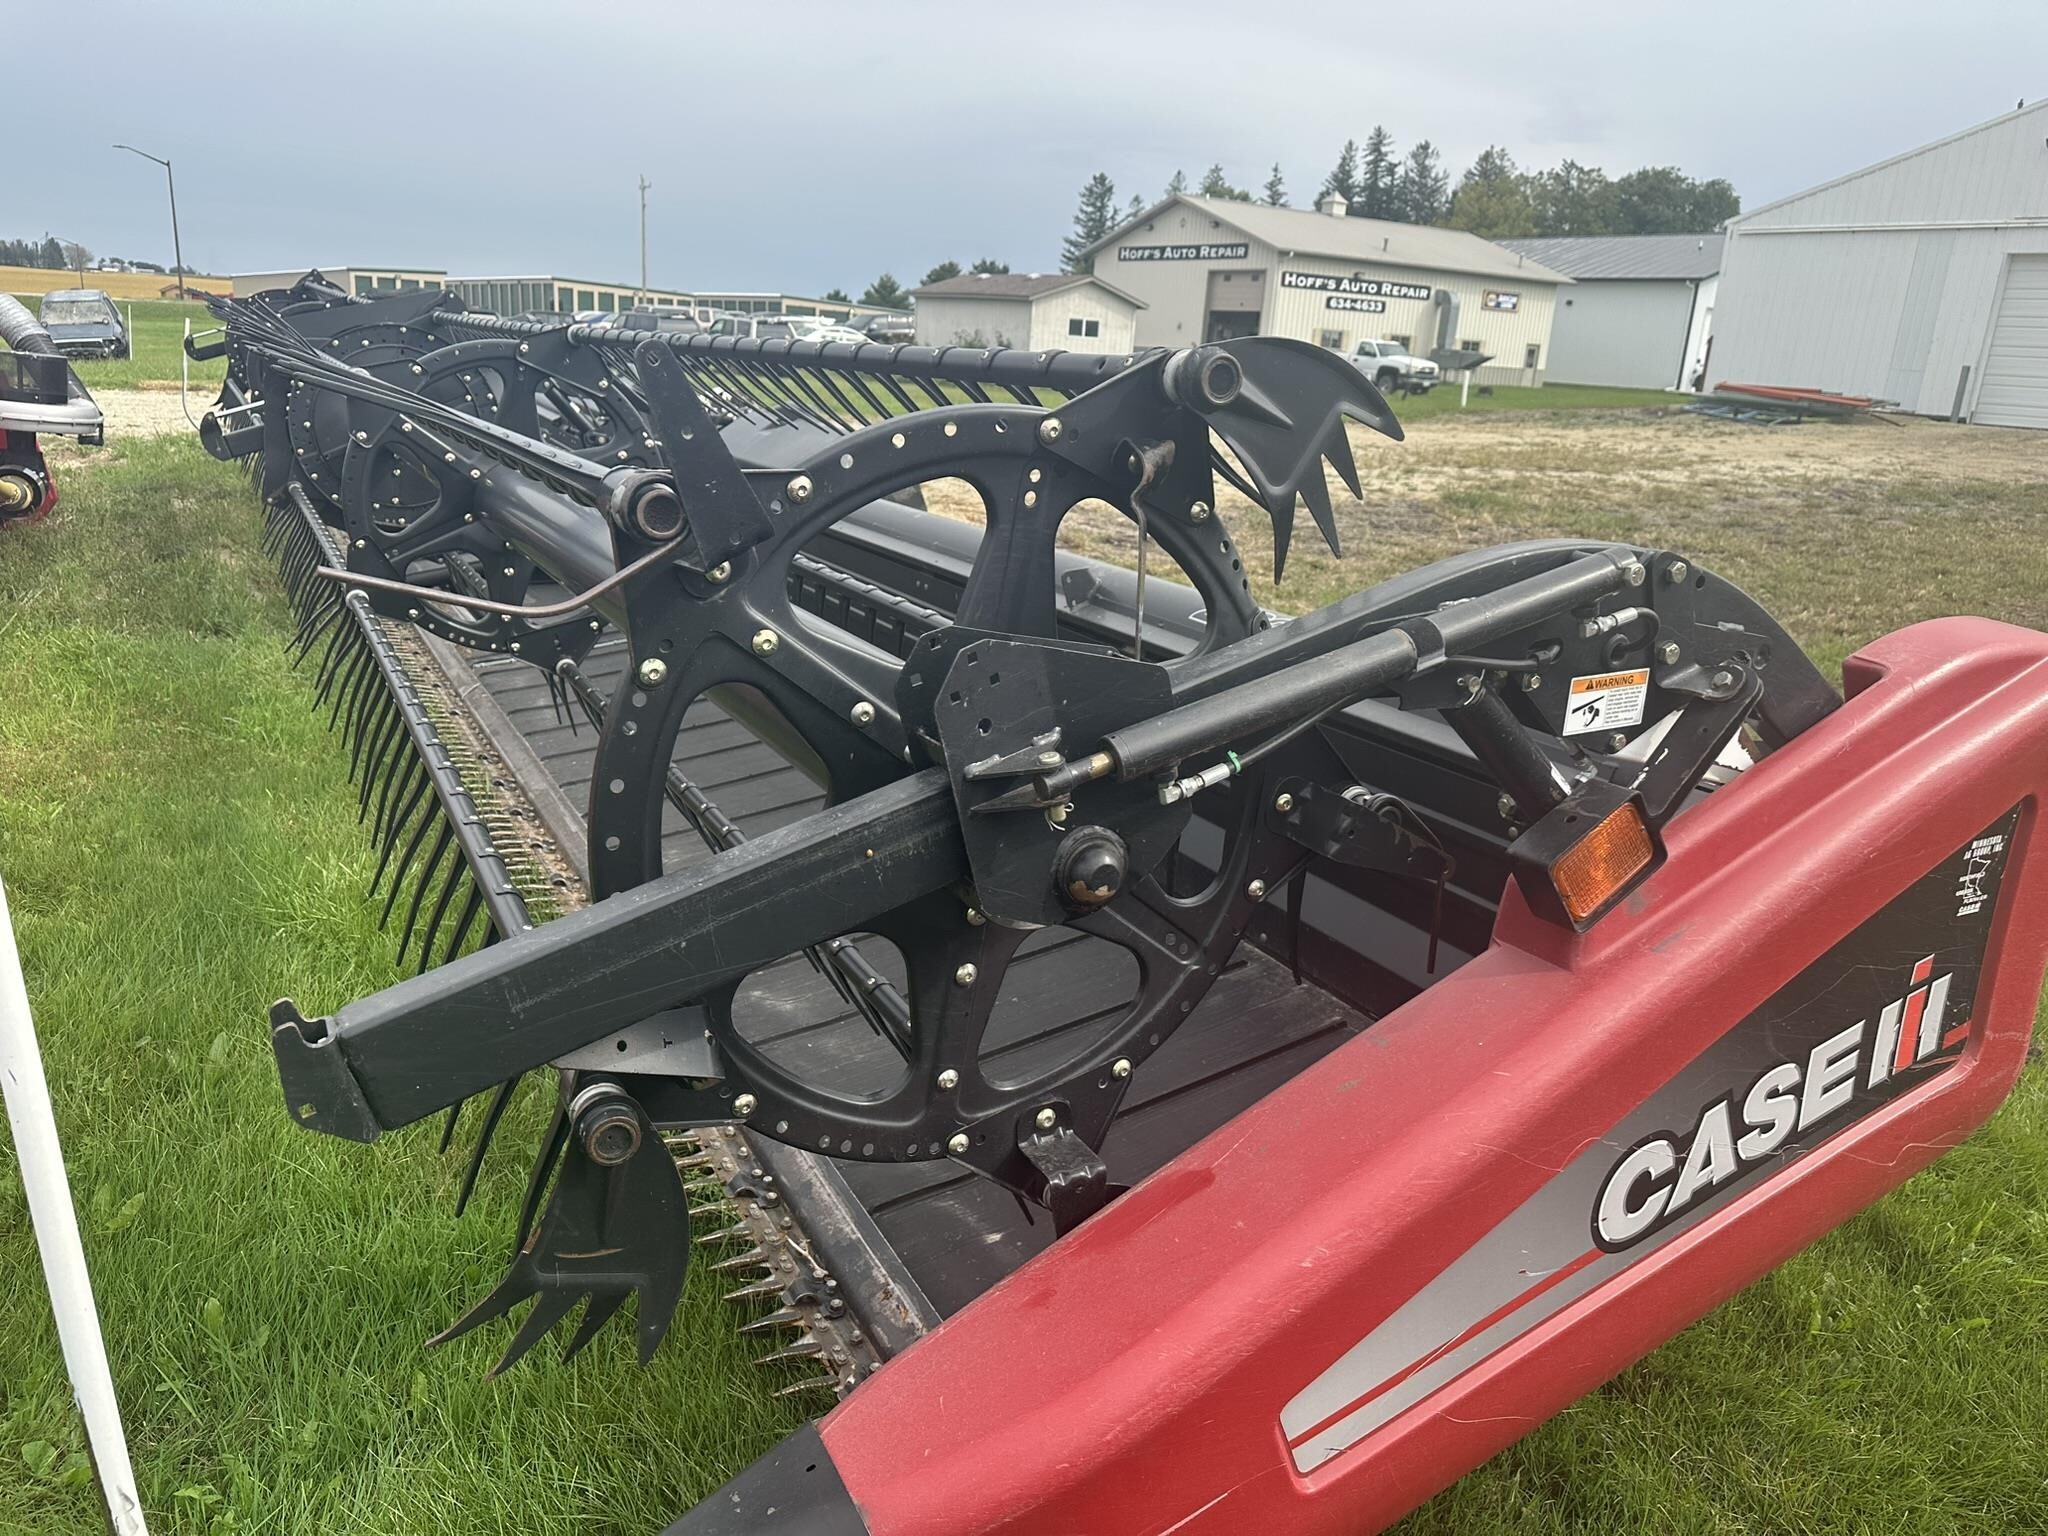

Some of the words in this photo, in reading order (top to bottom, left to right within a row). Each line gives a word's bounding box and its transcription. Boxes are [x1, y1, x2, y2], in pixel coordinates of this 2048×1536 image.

[1163, 246, 1196, 259] AUTO
[1200, 245, 1245, 258] REPAIR
[1339, 278, 1378, 294] AUTO
[1381, 282, 1429, 299] REPAIR
[1595, 675, 1634, 689] WARNING
[1598, 1019, 1866, 1243] CASE
